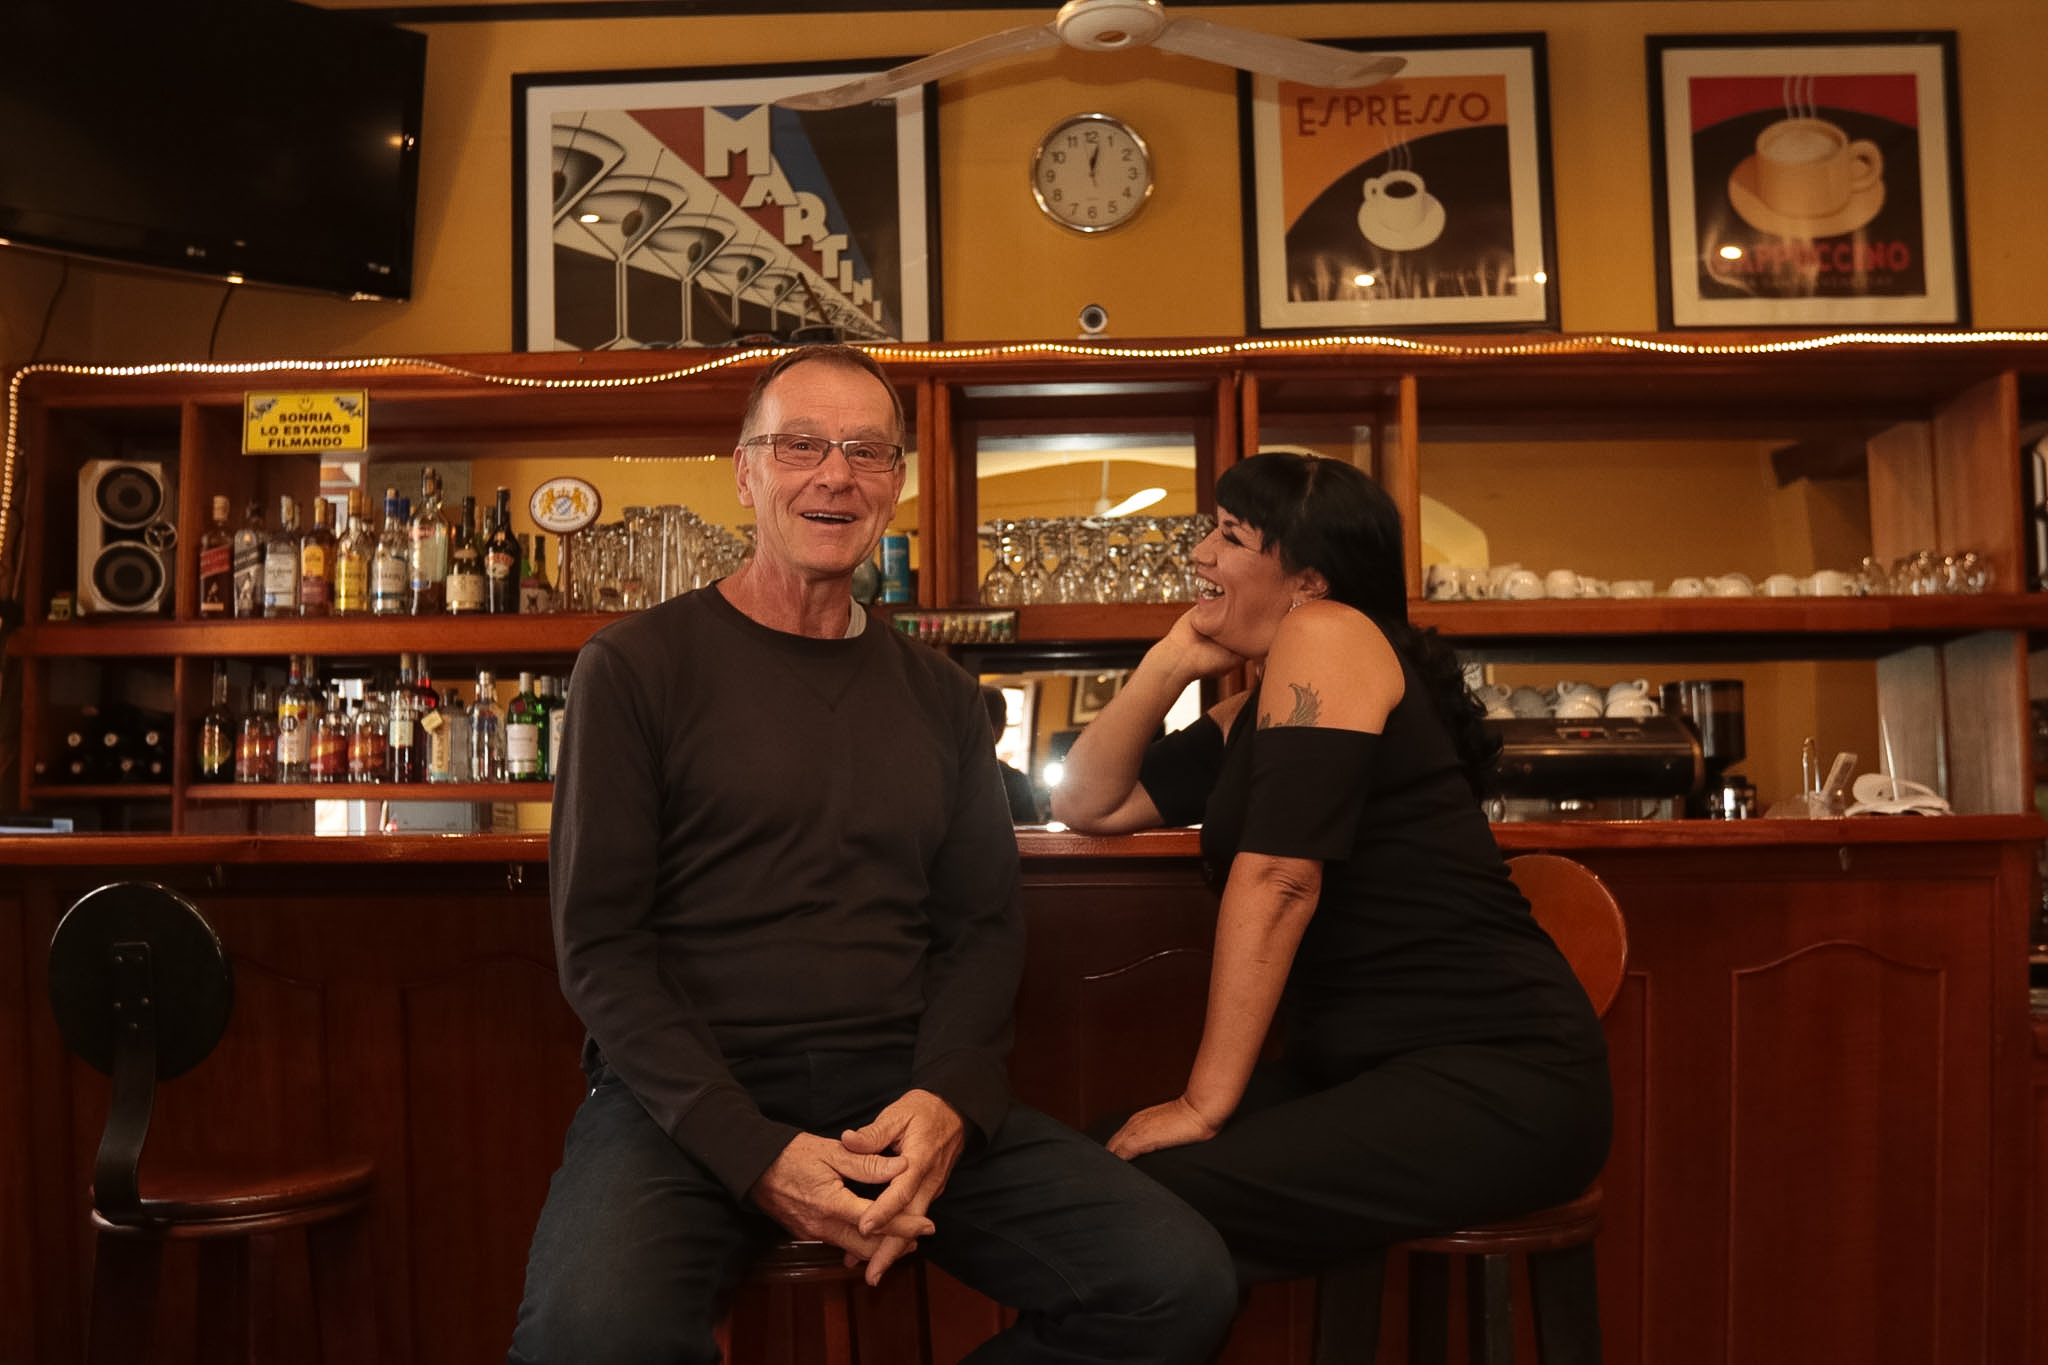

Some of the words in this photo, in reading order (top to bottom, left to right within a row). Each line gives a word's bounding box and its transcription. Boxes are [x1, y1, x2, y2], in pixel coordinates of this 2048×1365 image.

[1297, 92, 1490, 137] ESPRESSO
[1067, 136, 1078, 148] 11
[1085, 131, 1099, 144] 12
[1108, 136, 1113, 147] 1
[1052, 152, 1066, 164] 10
[1122, 149, 1132, 161] 2
[1046, 170, 1055, 183] 9
[1128, 168, 1138, 180] 3
[1053, 189, 1063, 201] 8
[1122, 187, 1131, 198] 4
[703, 103, 882, 323] MARTINI
[1070, 203, 1079, 215] 7
[1087, 206, 1097, 219] 6
[1108, 201, 1118, 213] 5
[280, 412, 333, 422] SONRIA
[261, 426, 279, 436] LO
[284, 424, 351, 435] ESTAMOS
[268, 437, 342, 448] FILMANDO
